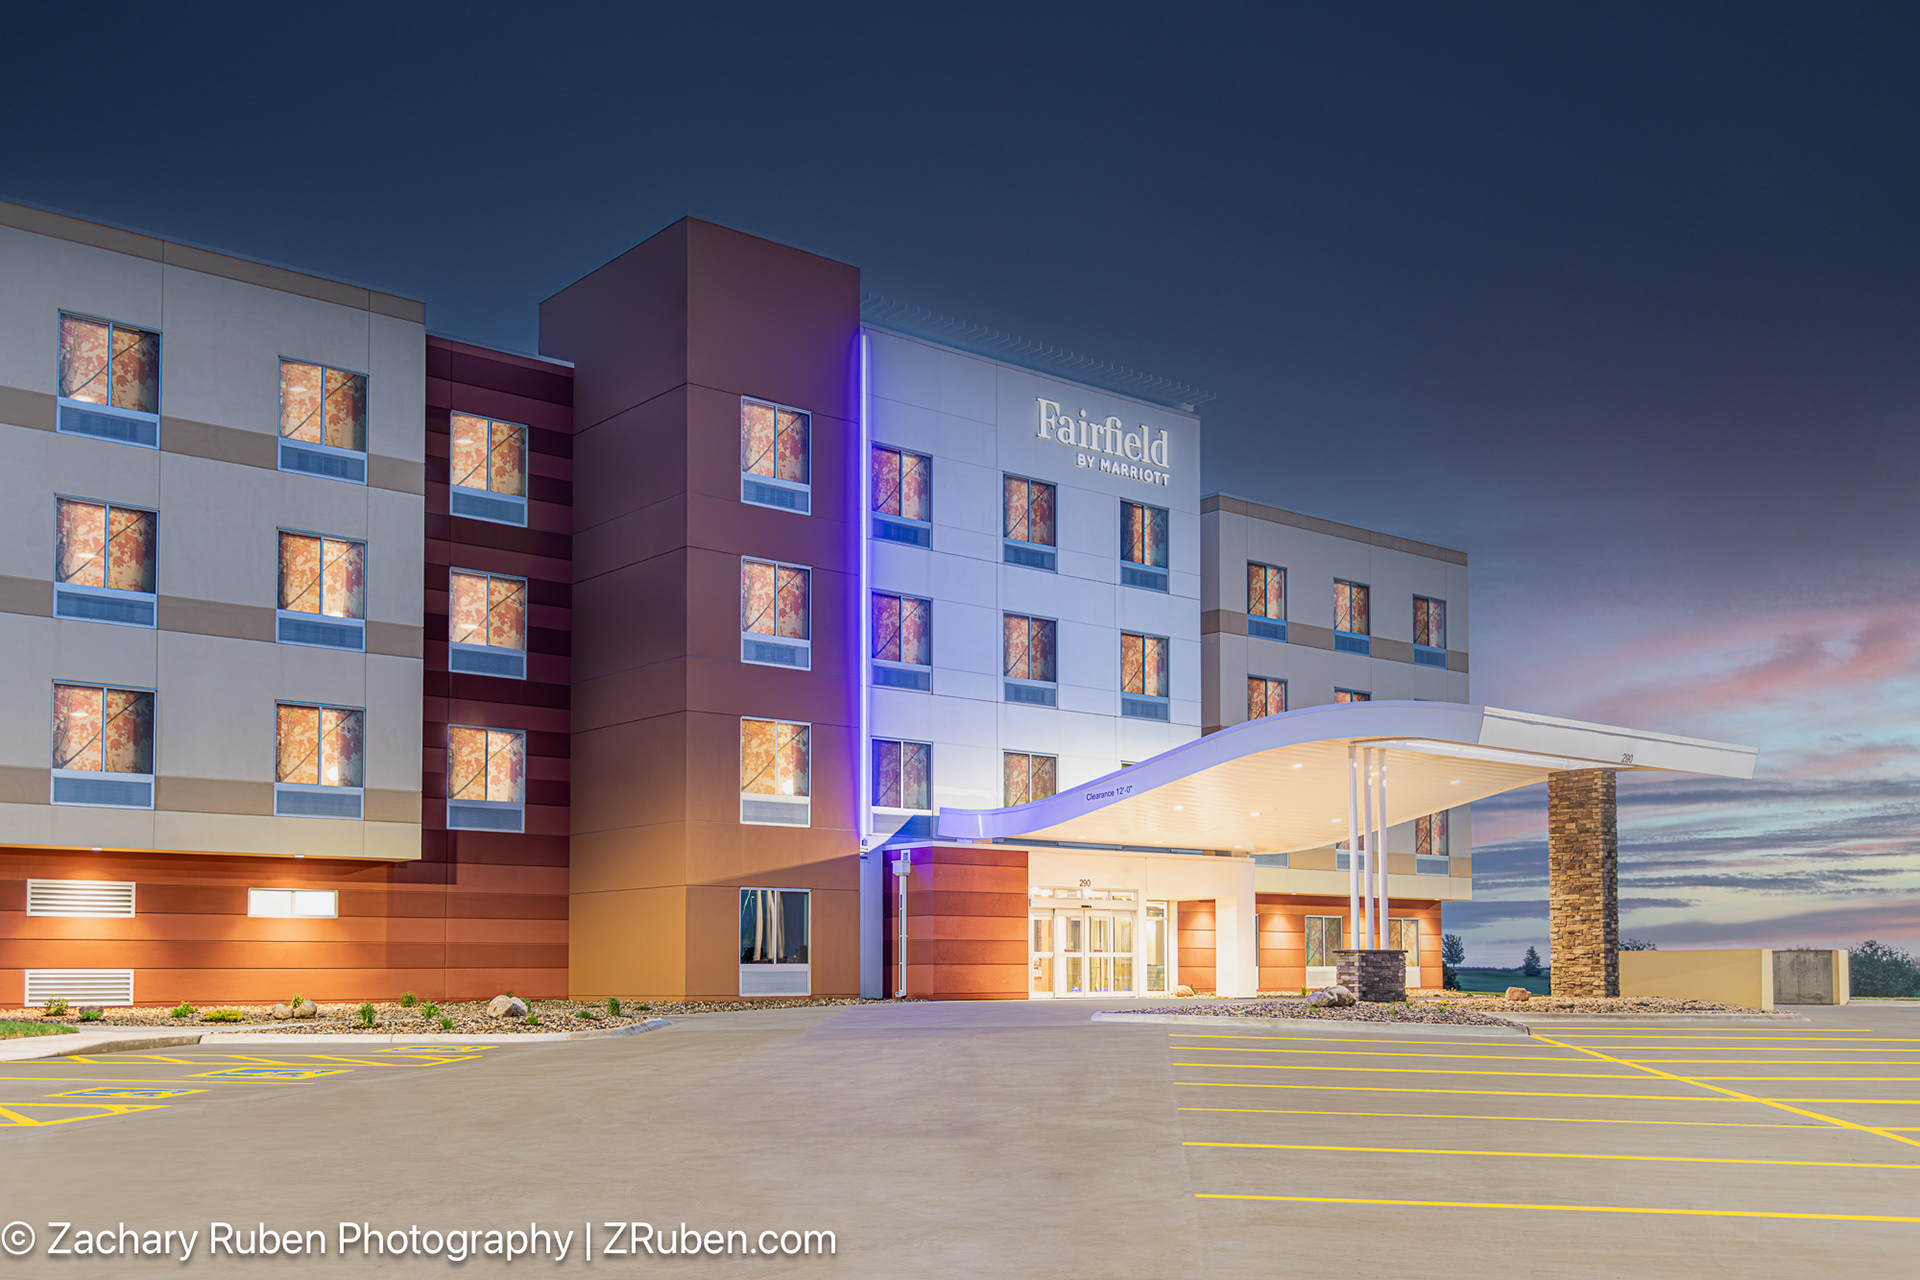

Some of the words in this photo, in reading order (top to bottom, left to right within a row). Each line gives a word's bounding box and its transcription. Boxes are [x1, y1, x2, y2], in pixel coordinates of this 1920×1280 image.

[1035, 397, 1170, 469] Fairfield
[1076, 453, 1095, 468] BY
[1099, 457, 1170, 486] MARRIOTT
[1621, 753, 1634, 763] 290
[1086, 790, 1115, 801] Clearance
[1079, 879, 1091, 887] 290
